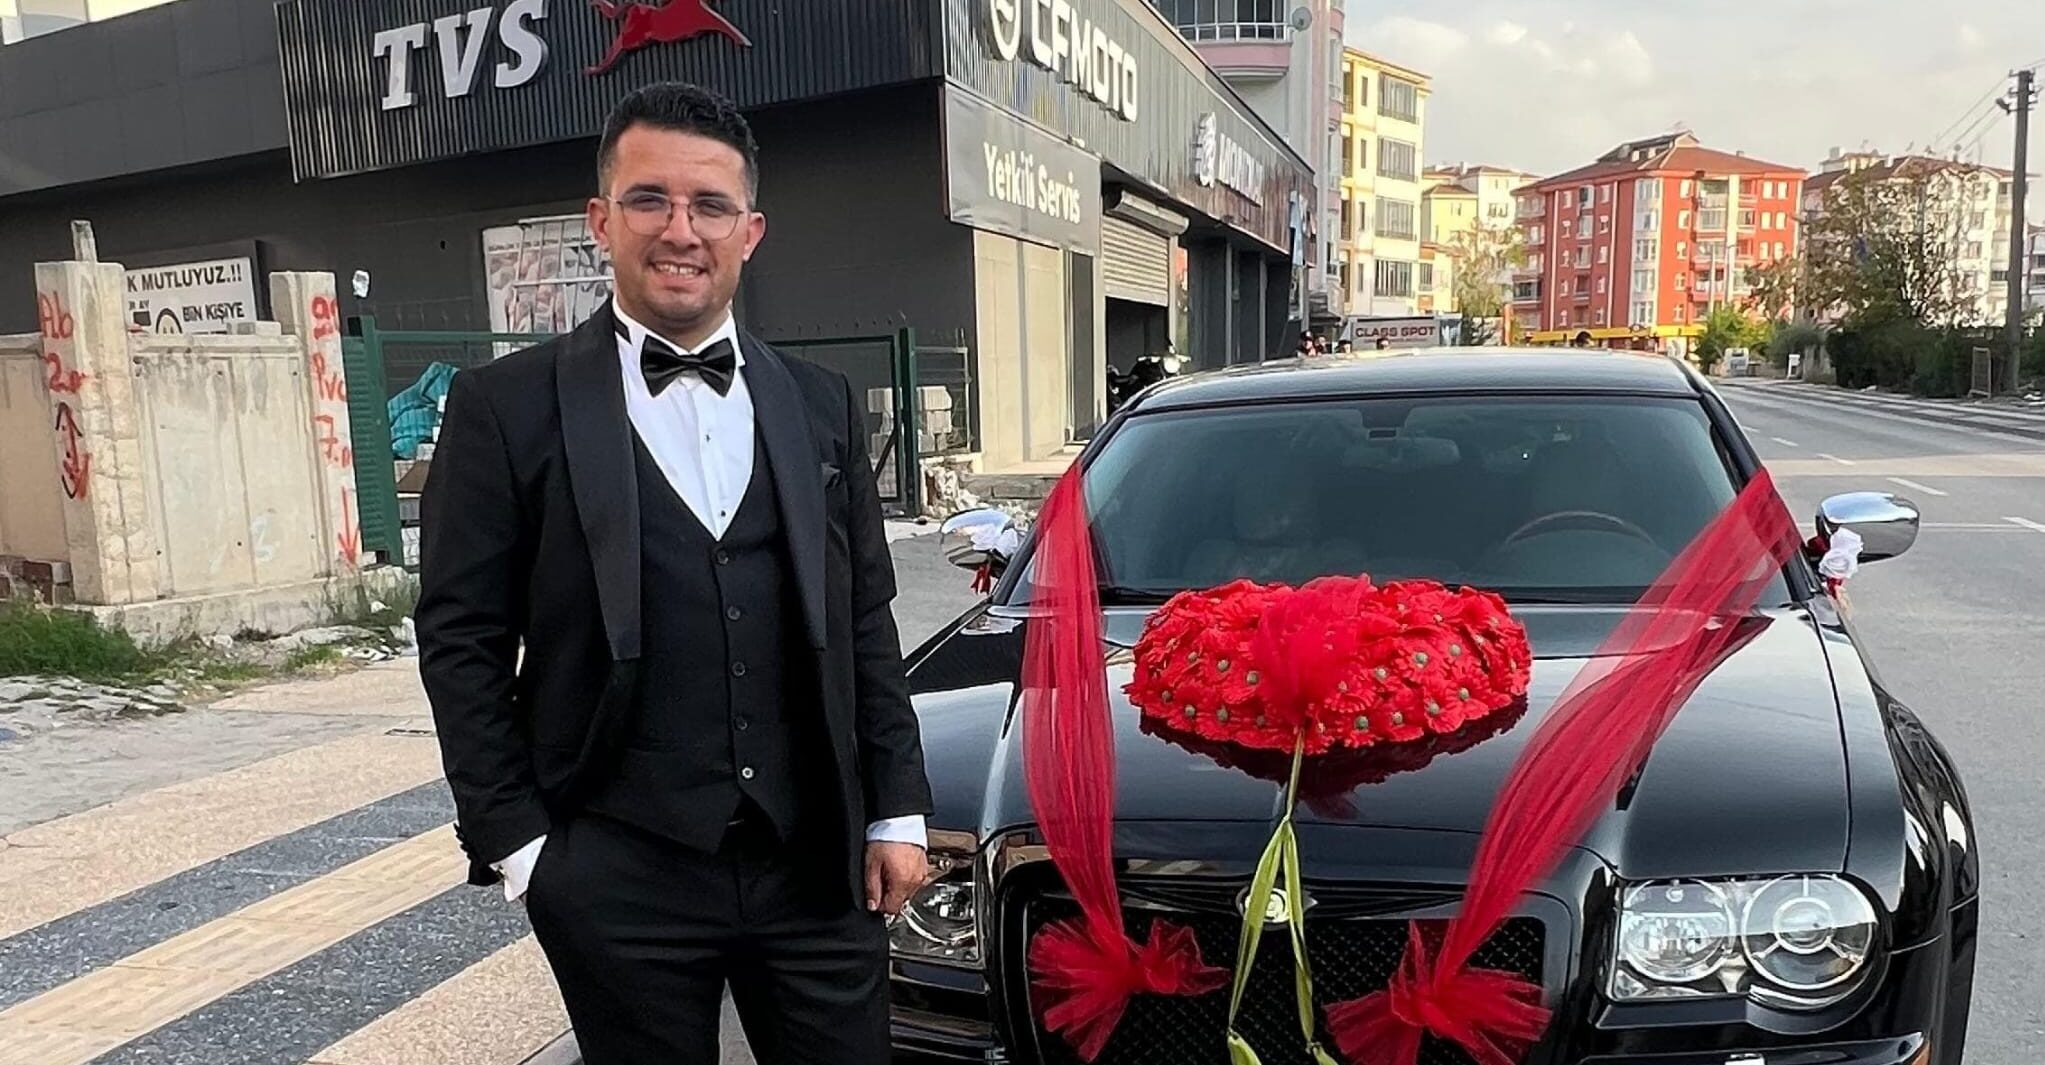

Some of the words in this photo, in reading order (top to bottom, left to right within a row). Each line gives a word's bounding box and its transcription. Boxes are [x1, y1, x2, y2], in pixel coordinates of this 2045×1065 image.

[373, 0, 548, 111] TVS
[1031, 0, 1138, 122] CFMOTO
[983, 141, 1035, 210] Yetkili
[1038, 164, 1080, 225] Servis
[142, 263, 242, 291] MUTLUYUZ.!!
[1355, 327, 1398, 338] CLASS
[1401, 326, 1436, 337] SPOT
